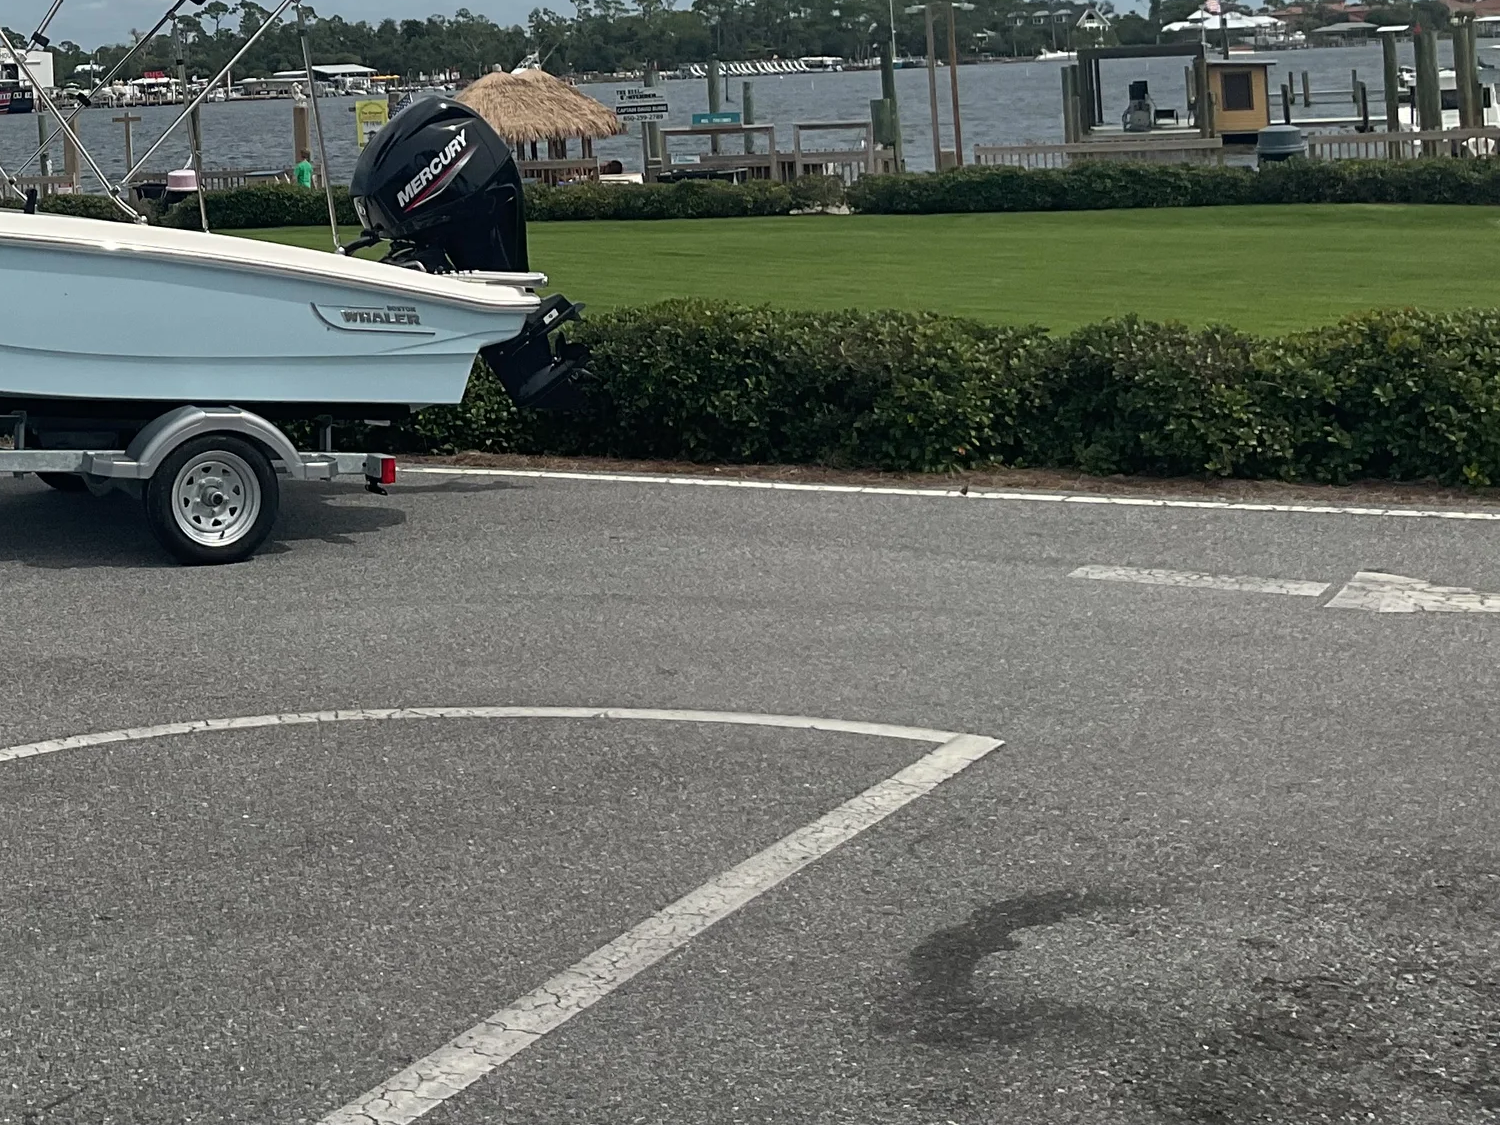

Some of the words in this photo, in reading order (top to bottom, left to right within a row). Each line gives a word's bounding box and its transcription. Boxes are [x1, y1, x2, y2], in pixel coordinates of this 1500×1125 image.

[396, 128, 467, 207] MERCURY
[340, 309, 422, 325] WHALER
[386, 305, 417, 313] BOSTON
